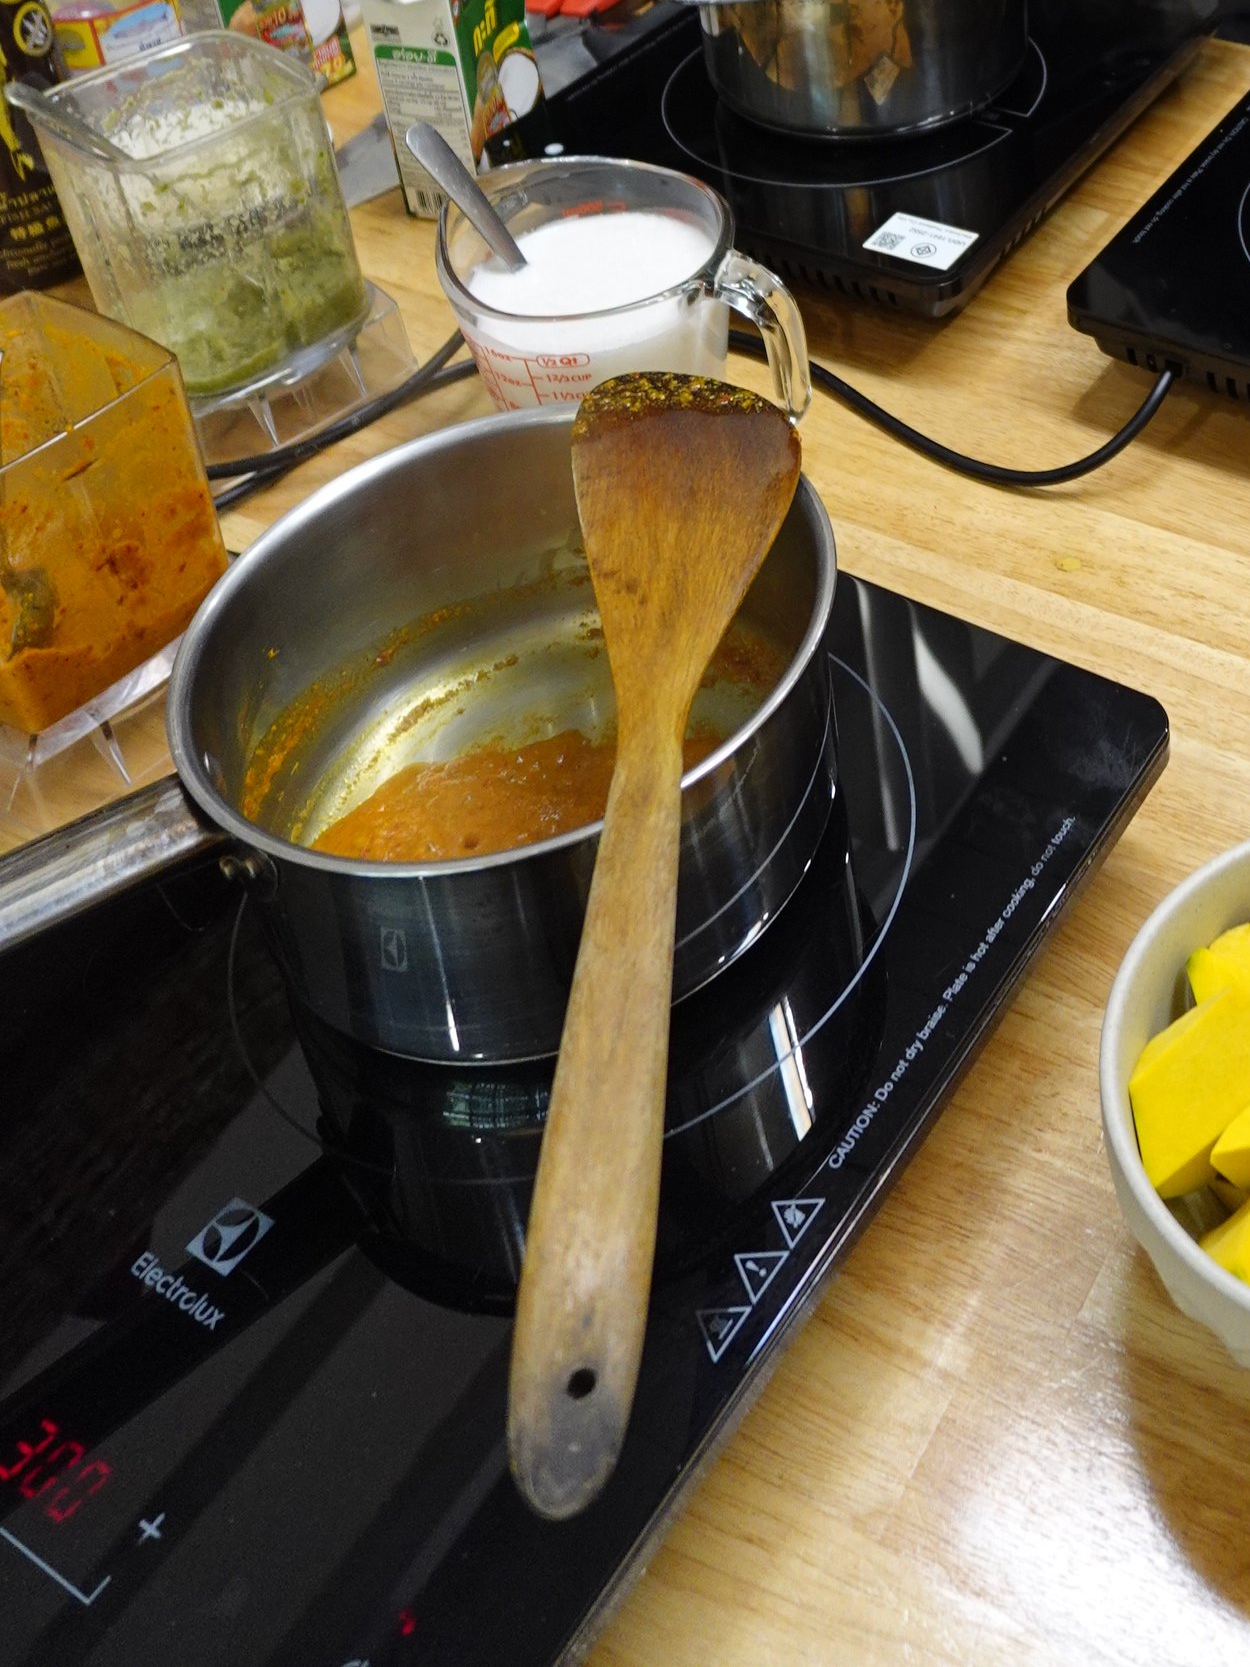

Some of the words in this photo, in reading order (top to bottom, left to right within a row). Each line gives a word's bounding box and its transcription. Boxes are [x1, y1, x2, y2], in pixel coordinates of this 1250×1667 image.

[828, 1100, 880, 1169] CAUTION:
[874, 1081, 894, 1102] Do
[891, 1059, 909, 1082] not
[906, 1040, 924, 1061] dry
[942, 972, 968, 1002] Plate
[962, 960, 976, 974] is
[970, 941, 989, 962] hot
[985, 917, 1005, 944] after
[1002, 877, 1036, 919] cooking,
[1031, 861, 1044, 877] do
[1041, 844, 1056, 862] not
[1051, 815, 1076, 845] touch.
[130, 1251, 225, 1331] Electrolux
[0, 1418, 112, 1524] 300
